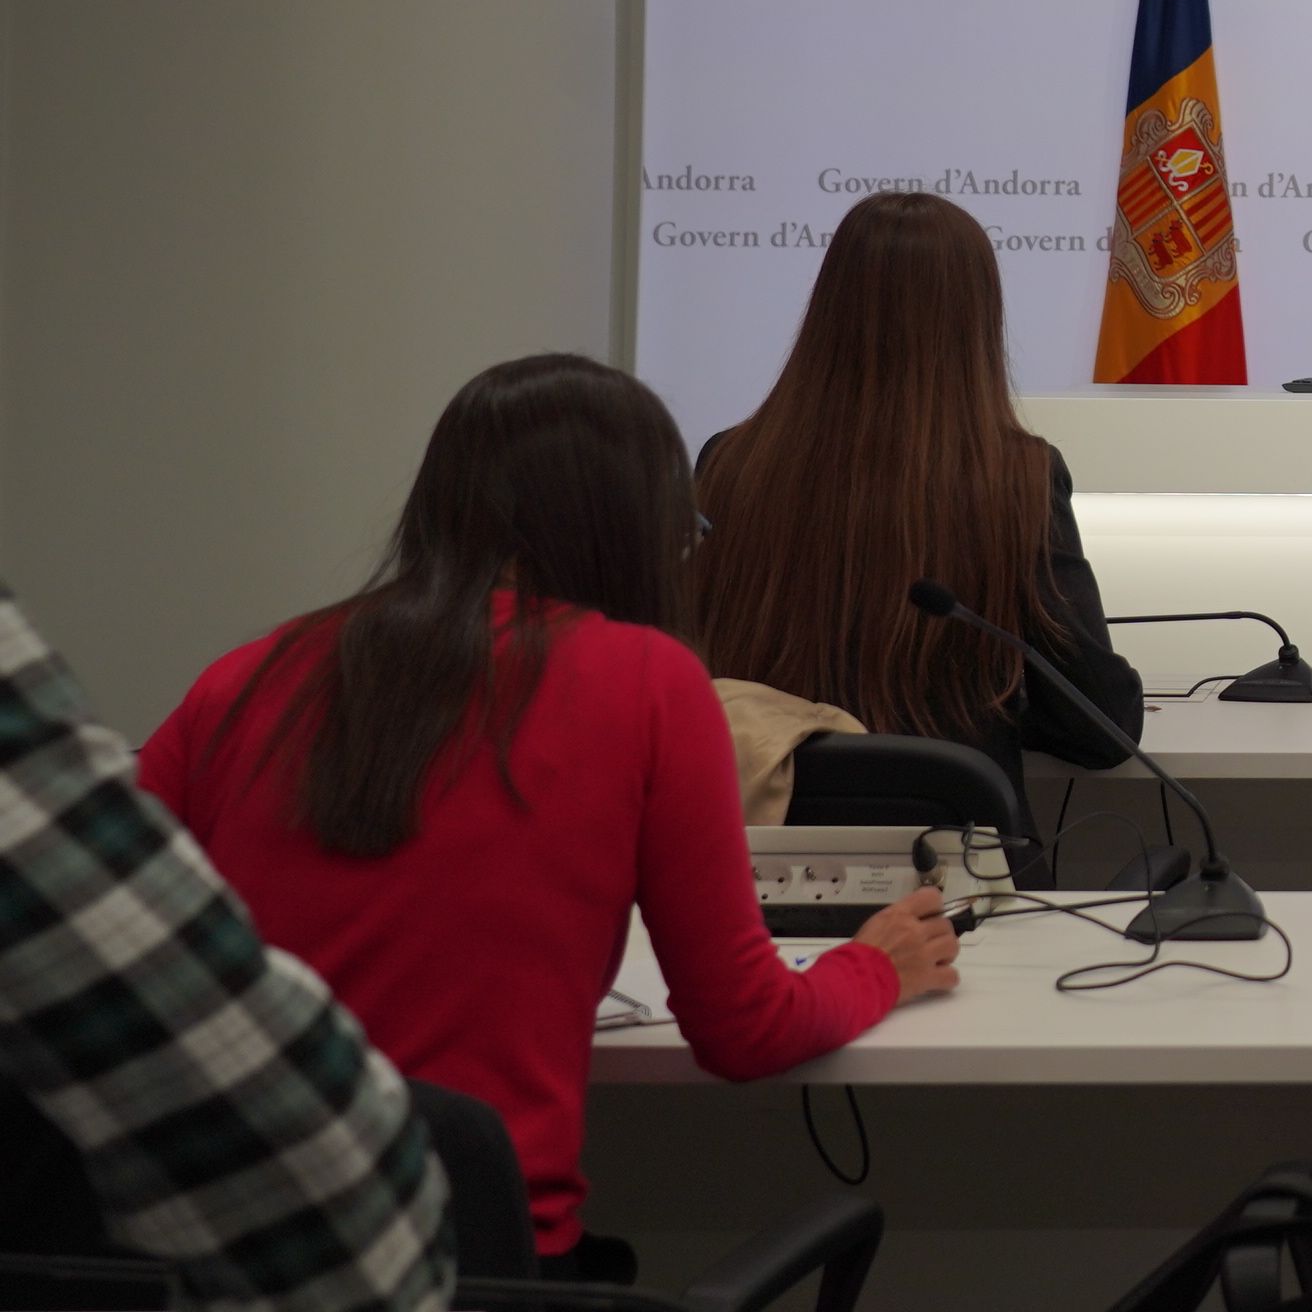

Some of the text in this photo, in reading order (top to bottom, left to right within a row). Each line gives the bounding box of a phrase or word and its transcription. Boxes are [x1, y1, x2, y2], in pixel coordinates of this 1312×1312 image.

[642, 164, 756, 192] ndorra
[817, 167, 1082, 196] Govern d’Andorra
[652, 221, 760, 248] Govern
